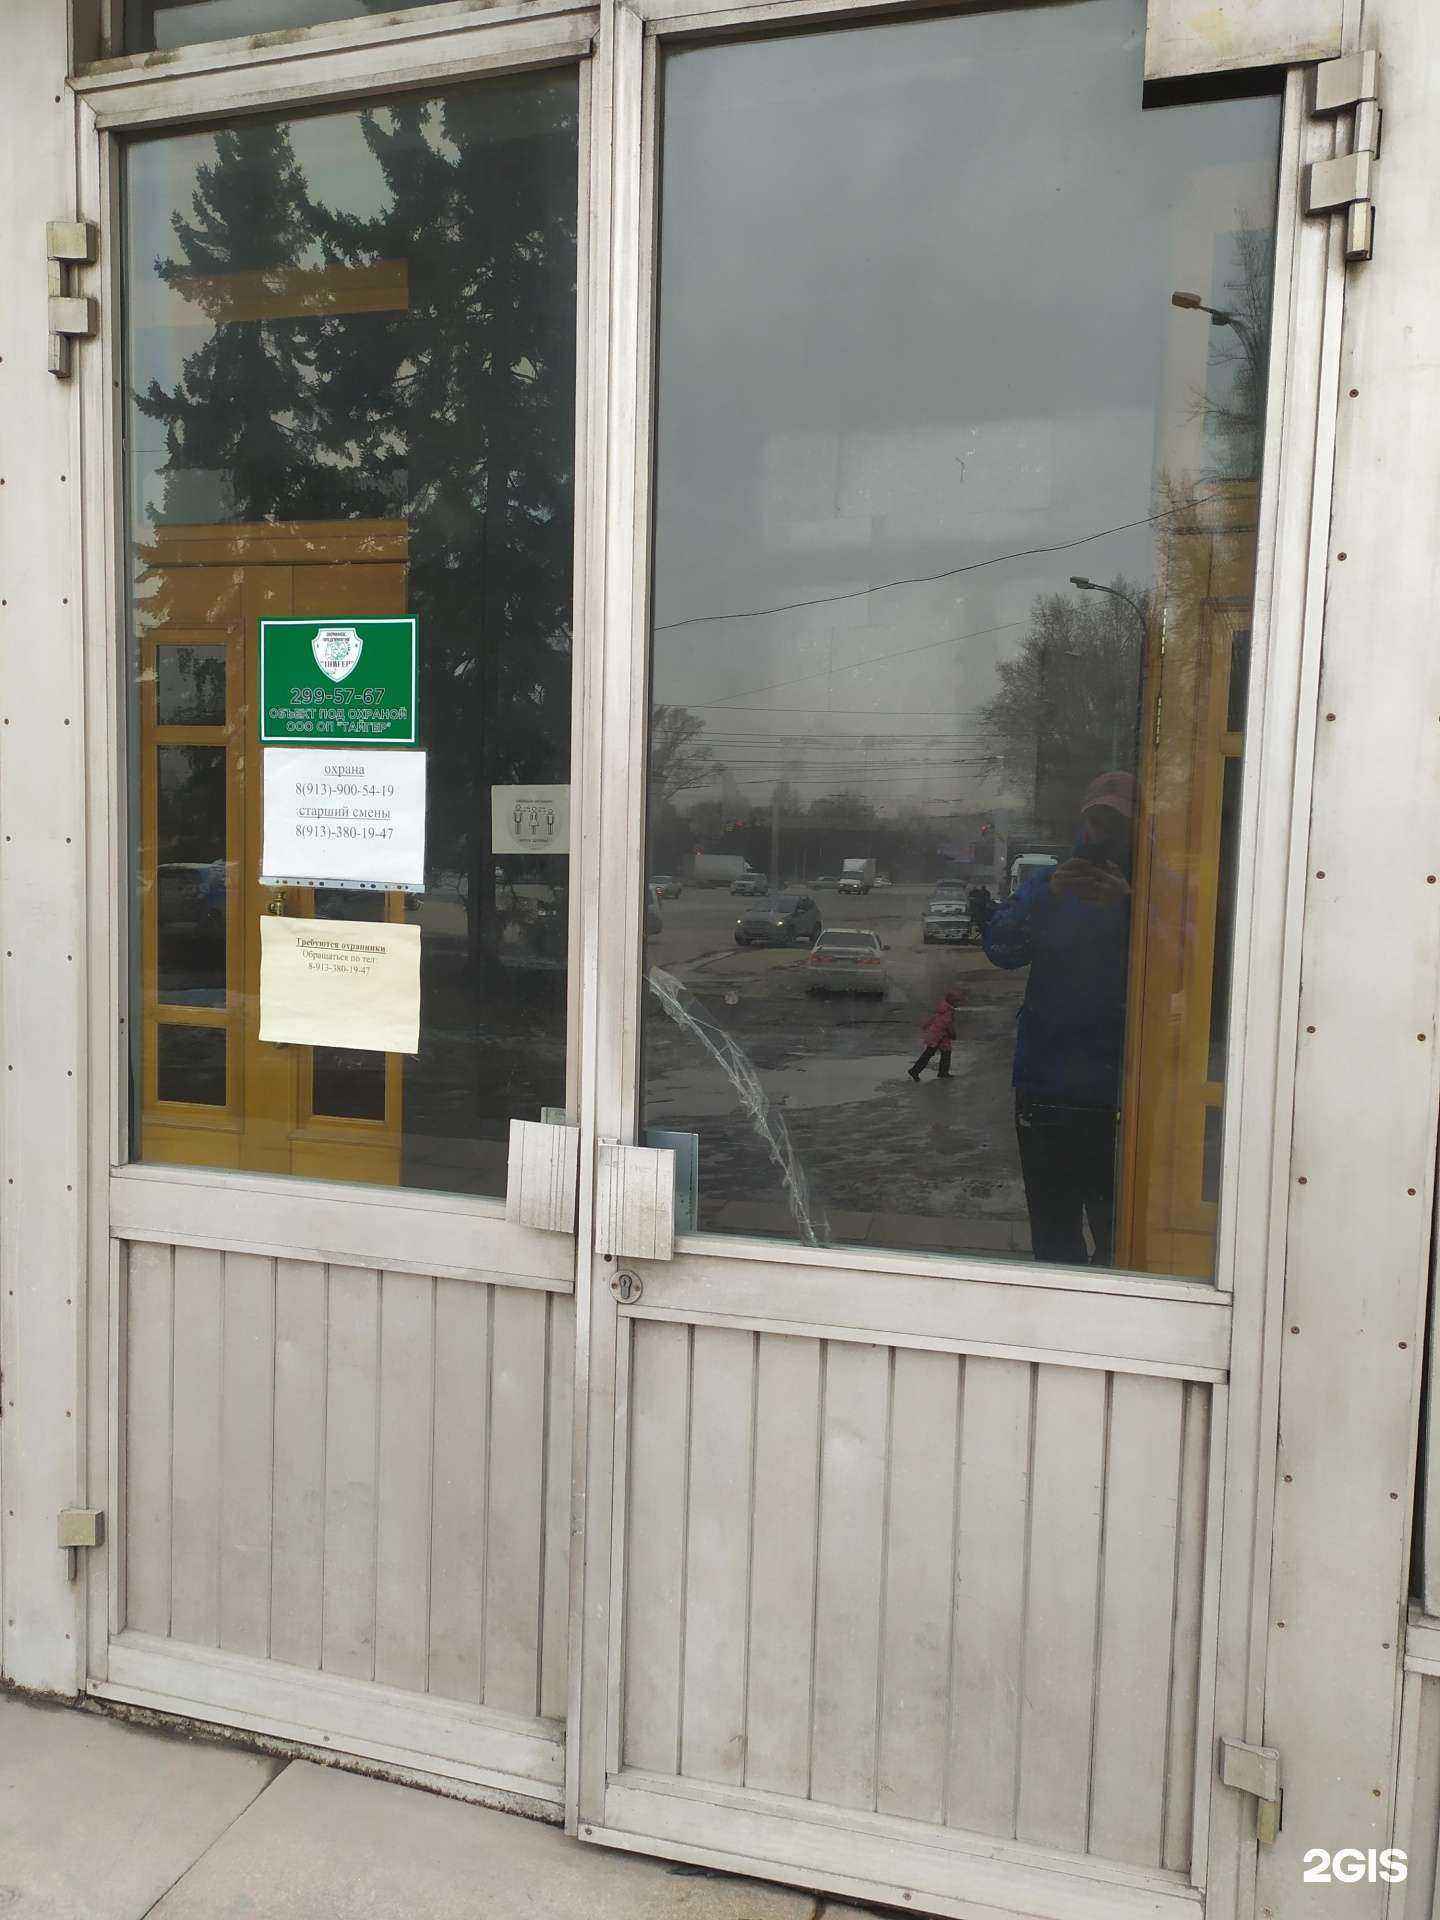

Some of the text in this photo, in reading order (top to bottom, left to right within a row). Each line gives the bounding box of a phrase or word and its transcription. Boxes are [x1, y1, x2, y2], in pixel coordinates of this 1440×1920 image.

[290, 688, 385, 704] 299-57-67
[269, 707, 407, 720] ОБЪЕКТ ПОД ОХРАНОЙ
[286, 721, 313, 732] ООО
[317, 721, 334, 732] ОП
[324, 764, 365, 777] охрана
[295, 782, 394, 798] 8(913)-900-54-19
[299, 806, 391, 819] старший смены
[295, 824, 394, 840] 8(913)-380-19-47
[296, 937, 339, 949] Требуются
[302, 950, 349, 962] Обращаться
